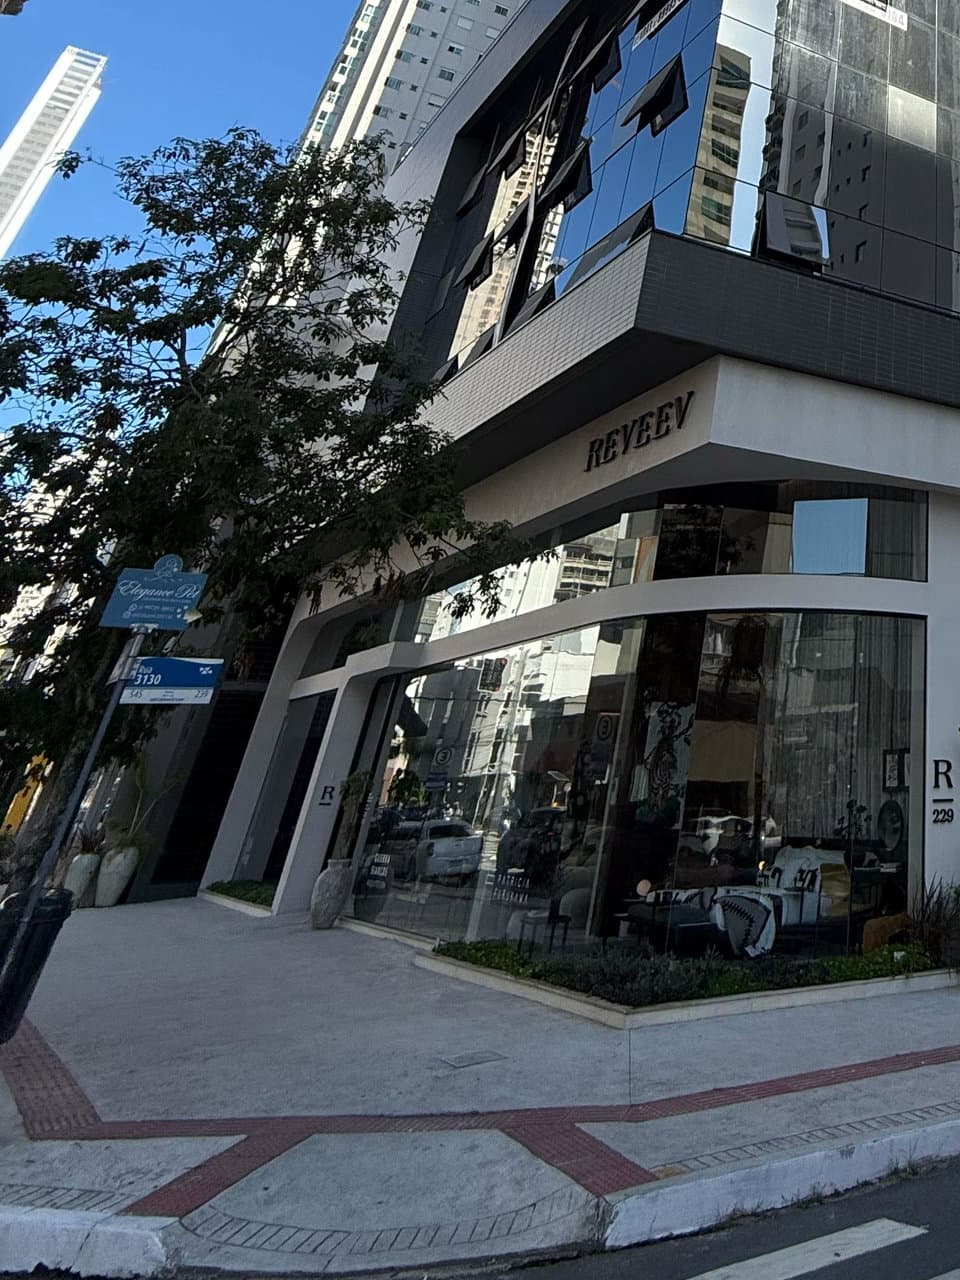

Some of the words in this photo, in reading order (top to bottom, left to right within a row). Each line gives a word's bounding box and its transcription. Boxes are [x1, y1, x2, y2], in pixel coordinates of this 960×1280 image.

[134, 674, 162, 685] 3130
[933, 759, 953, 789] R
[320, 785, 336, 801] R
[932, 808, 954, 824] 229
